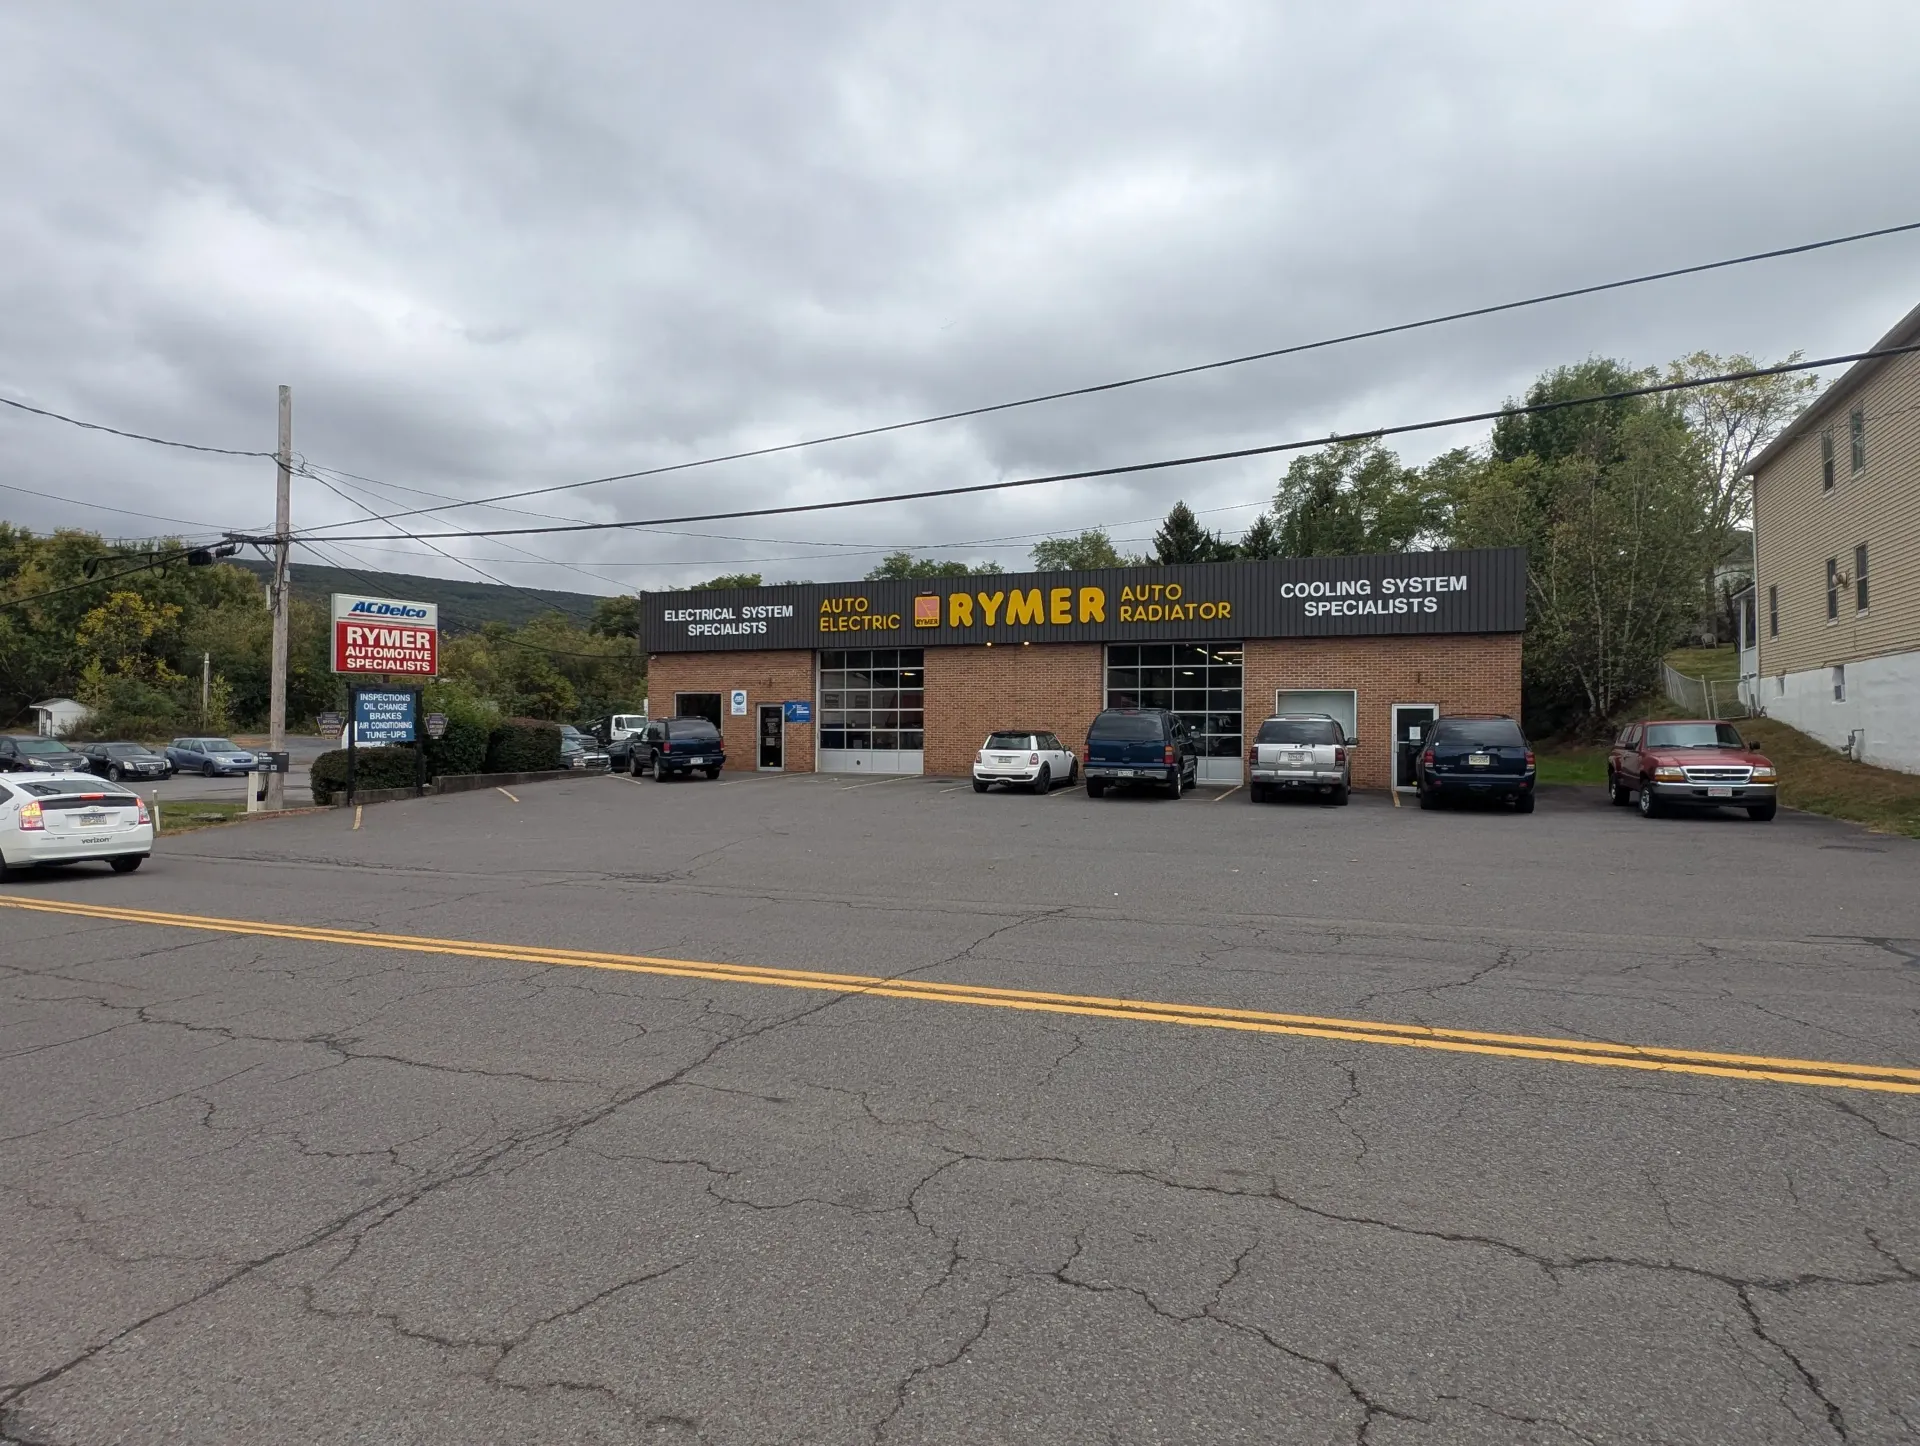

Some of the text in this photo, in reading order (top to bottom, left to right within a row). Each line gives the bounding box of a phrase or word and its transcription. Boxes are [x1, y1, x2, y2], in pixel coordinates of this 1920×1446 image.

[1121, 583, 1182, 602] AUTO
[1280, 575, 1468, 598] COOLING SYSTEM
[351, 601, 427, 619] ACDelco
[820, 597, 868, 613] AUTO
[949, 586, 1106, 628] RYMER
[1120, 602, 1231, 623] RADIATOR
[1304, 597, 1438, 617] SPECIALISTS
[664, 605, 794, 622] ELECTRICAL SYSTEM
[687, 621, 767, 636] SPECIALISTS
[820, 614, 901, 632] ELECTRIC
[916, 618, 939, 626] RYMER
[347, 626, 431, 649] RYMER
[345, 646, 432, 661] AUTOMOTIVE
[347, 658, 430, 671] SPECIALISTS
[360, 693, 411, 703] INSPECTIONS
[363, 702, 408, 711] OIL CHANGE
[369, 712, 402, 720] BRAKES
[358, 721, 413, 730] AIR CONDITIONING
[365, 730, 407, 739] TUNE-UPS
